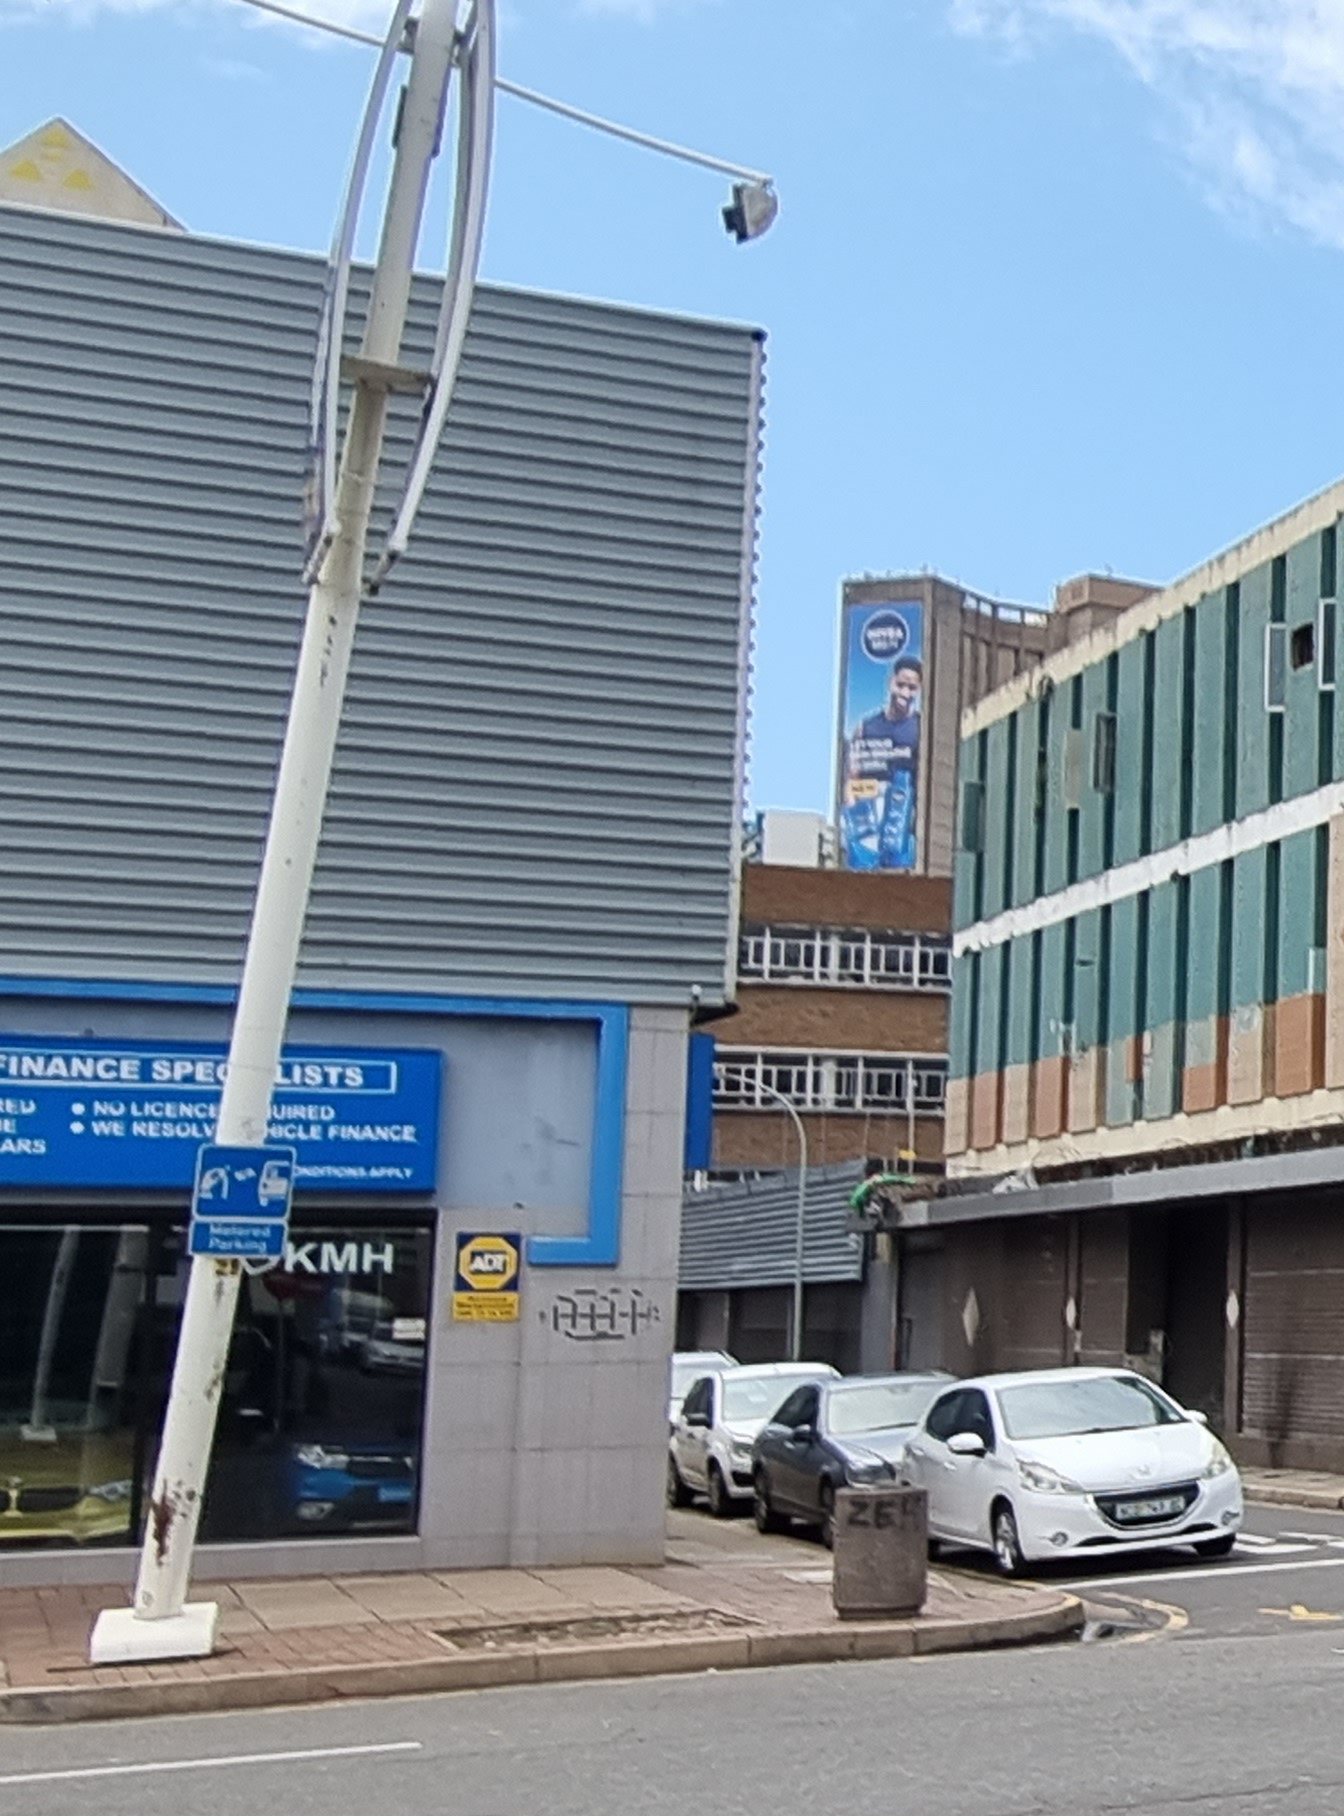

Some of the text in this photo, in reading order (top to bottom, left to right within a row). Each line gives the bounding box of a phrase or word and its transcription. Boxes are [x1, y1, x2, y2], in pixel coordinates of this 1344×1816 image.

[0, 1055, 363, 1087] INANCE SPECLISTS
[92, 1101, 126, 1117] NO
[91, 1120, 125, 1136] WE
[132, 1121, 217, 1138] RESOLV
[327, 1124, 418, 1142] FINANCE
[209, 1222, 271, 1238] Metered
[208, 1238, 267, 1253] Parking
[283, 1242, 394, 1274] KMH
[469, 1252, 509, 1273] ADT
